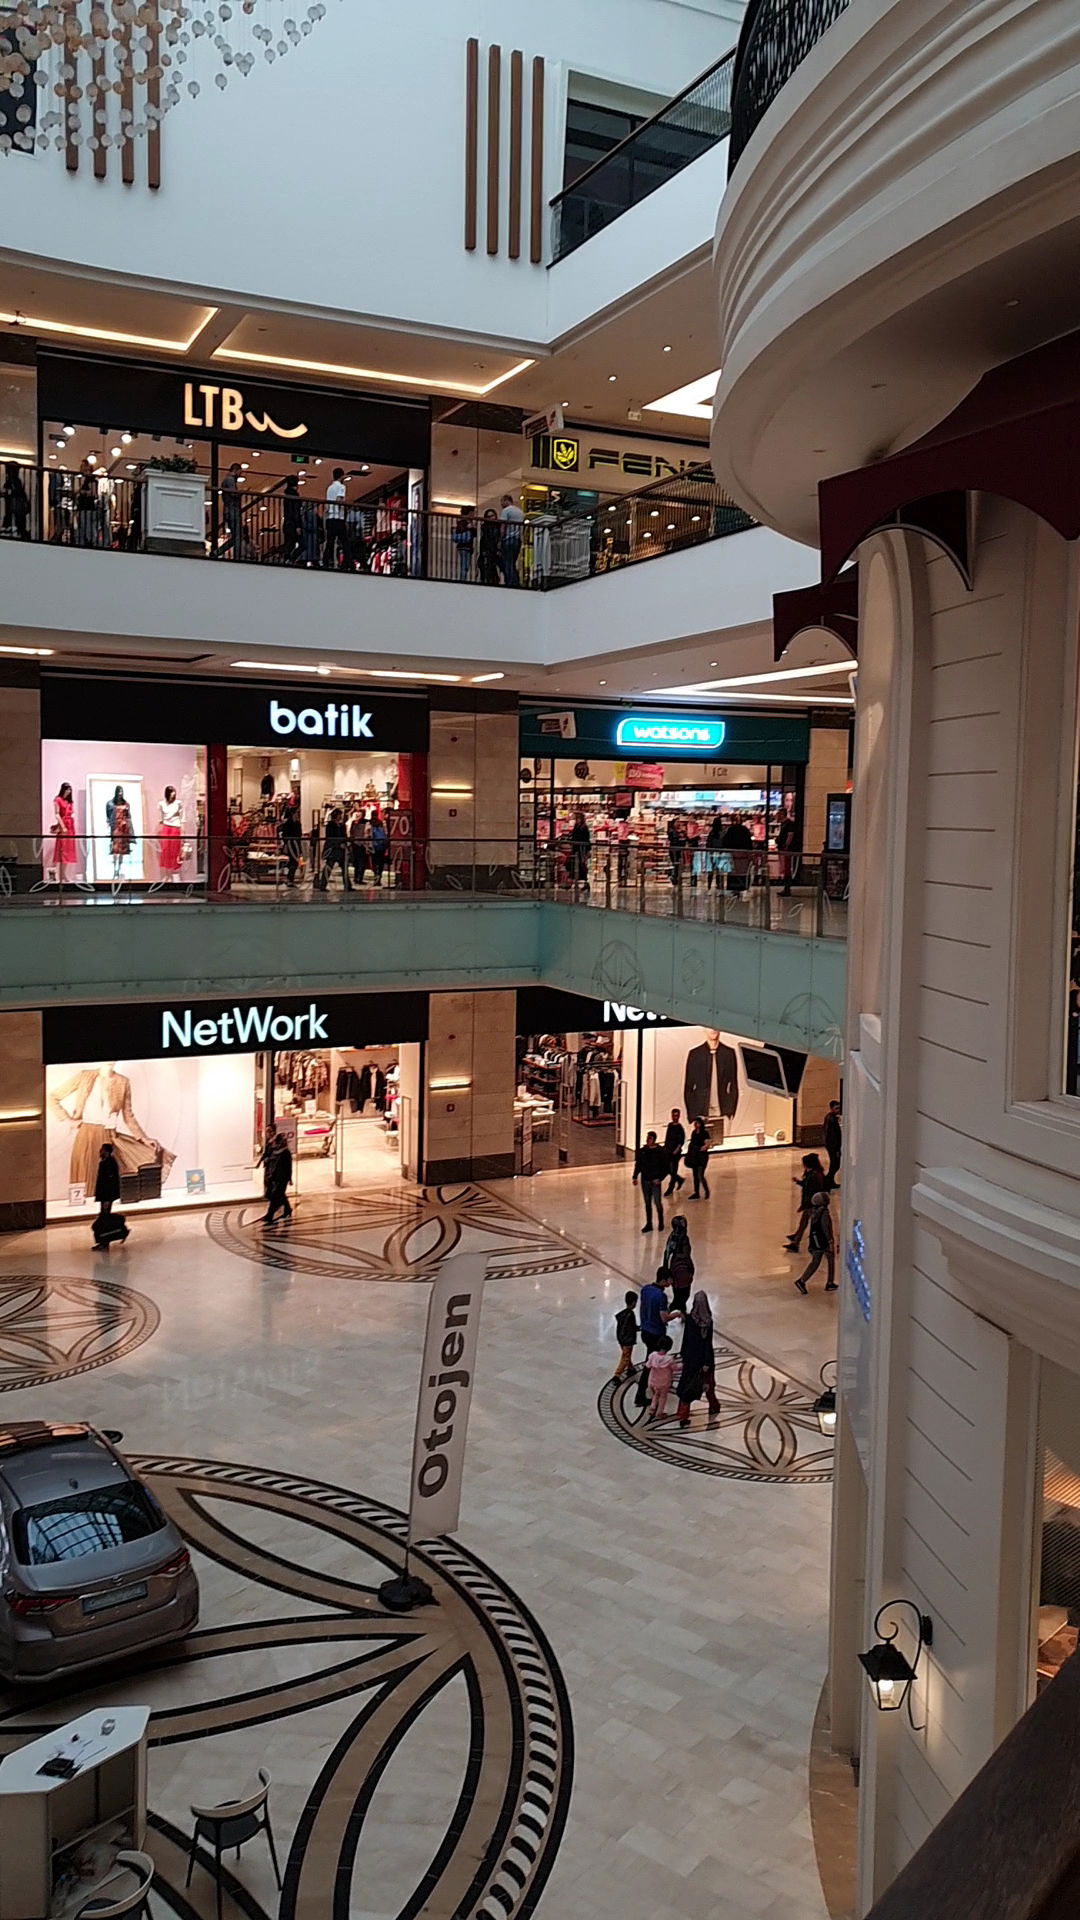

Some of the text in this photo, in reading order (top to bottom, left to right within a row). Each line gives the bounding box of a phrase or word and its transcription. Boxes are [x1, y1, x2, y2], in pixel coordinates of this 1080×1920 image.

[184, 383, 244, 431] LTB
[269, 700, 375, 738] batik
[633, 725, 711, 742] watsons
[162, 1003, 329, 1049] NetWork
[418, 1293, 472, 1498] Otojen
